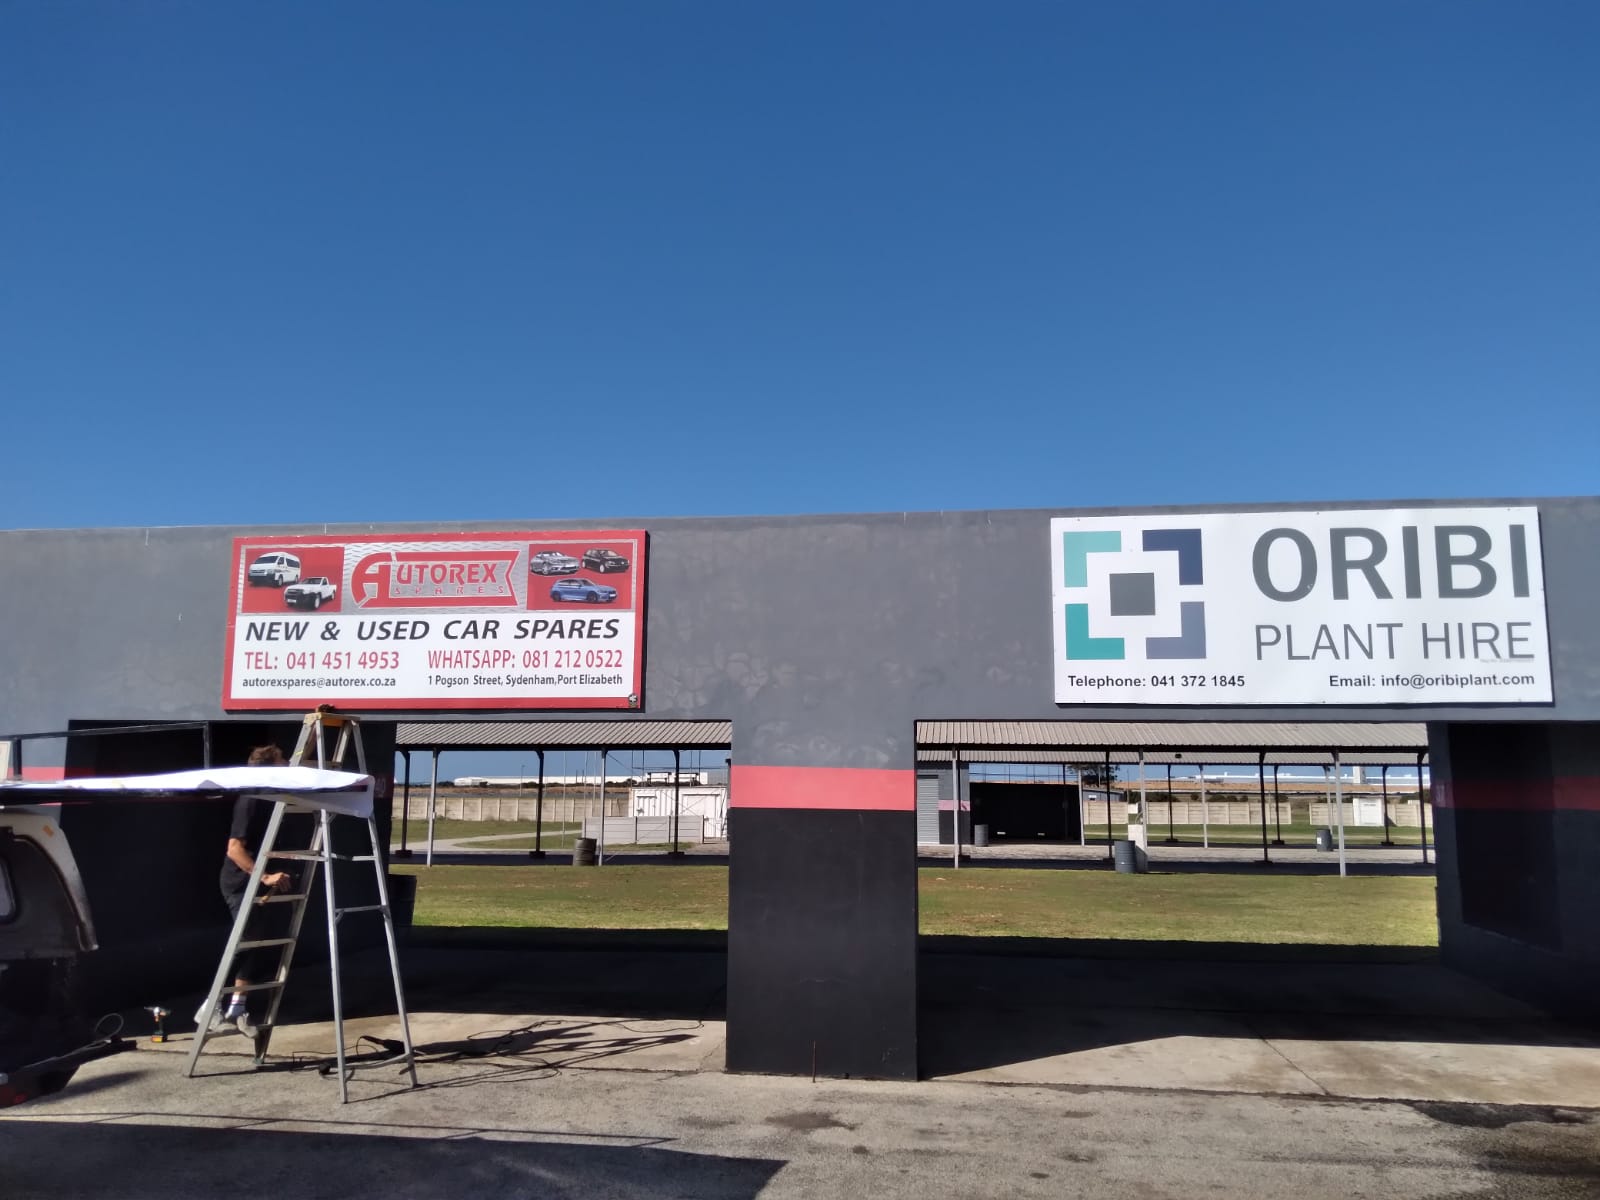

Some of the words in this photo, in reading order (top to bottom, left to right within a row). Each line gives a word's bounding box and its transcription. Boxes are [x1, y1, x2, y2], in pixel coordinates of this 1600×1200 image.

[1251, 523, 1531, 602] ORIBI
[351, 551, 498, 604] AUTOREX
[394, 584, 505, 595] SPARES
[245, 621, 309, 641] NEW
[320, 620, 341, 641] &
[357, 620, 430, 641] USED
[443, 619, 500, 640] CAR
[514, 618, 620, 639] SPARES
[1255, 622, 1403, 660] PLANT
[1422, 621, 1535, 660] HIRE
[244, 651, 278, 670] TEL:
[286, 651, 316, 670] 041
[322, 651, 352, 670] 451
[358, 651, 400, 670] 4953
[428, 649, 516, 669] WHATSAPP:
[522, 649, 549, 668] 081
[554, 649, 581, 668] 212
[585, 649, 623, 668] 0522
[242, 677, 396, 689] autorexspares@autorex.co.za
[428, 675, 433, 685] 1
[435, 675, 469, 687] Pogson
[473, 674, 503, 686] Street,
[579, 674, 623, 685] Elizabeth
[1068, 675, 1146, 689] Telephone:
[1151, 675, 1176, 687] 041
[1181, 675, 1206, 687] 372
[1211, 675, 1245, 687] 1845
[1329, 675, 1376, 687] Email:
[1381, 674, 1535, 689] info@oribiplant.com
